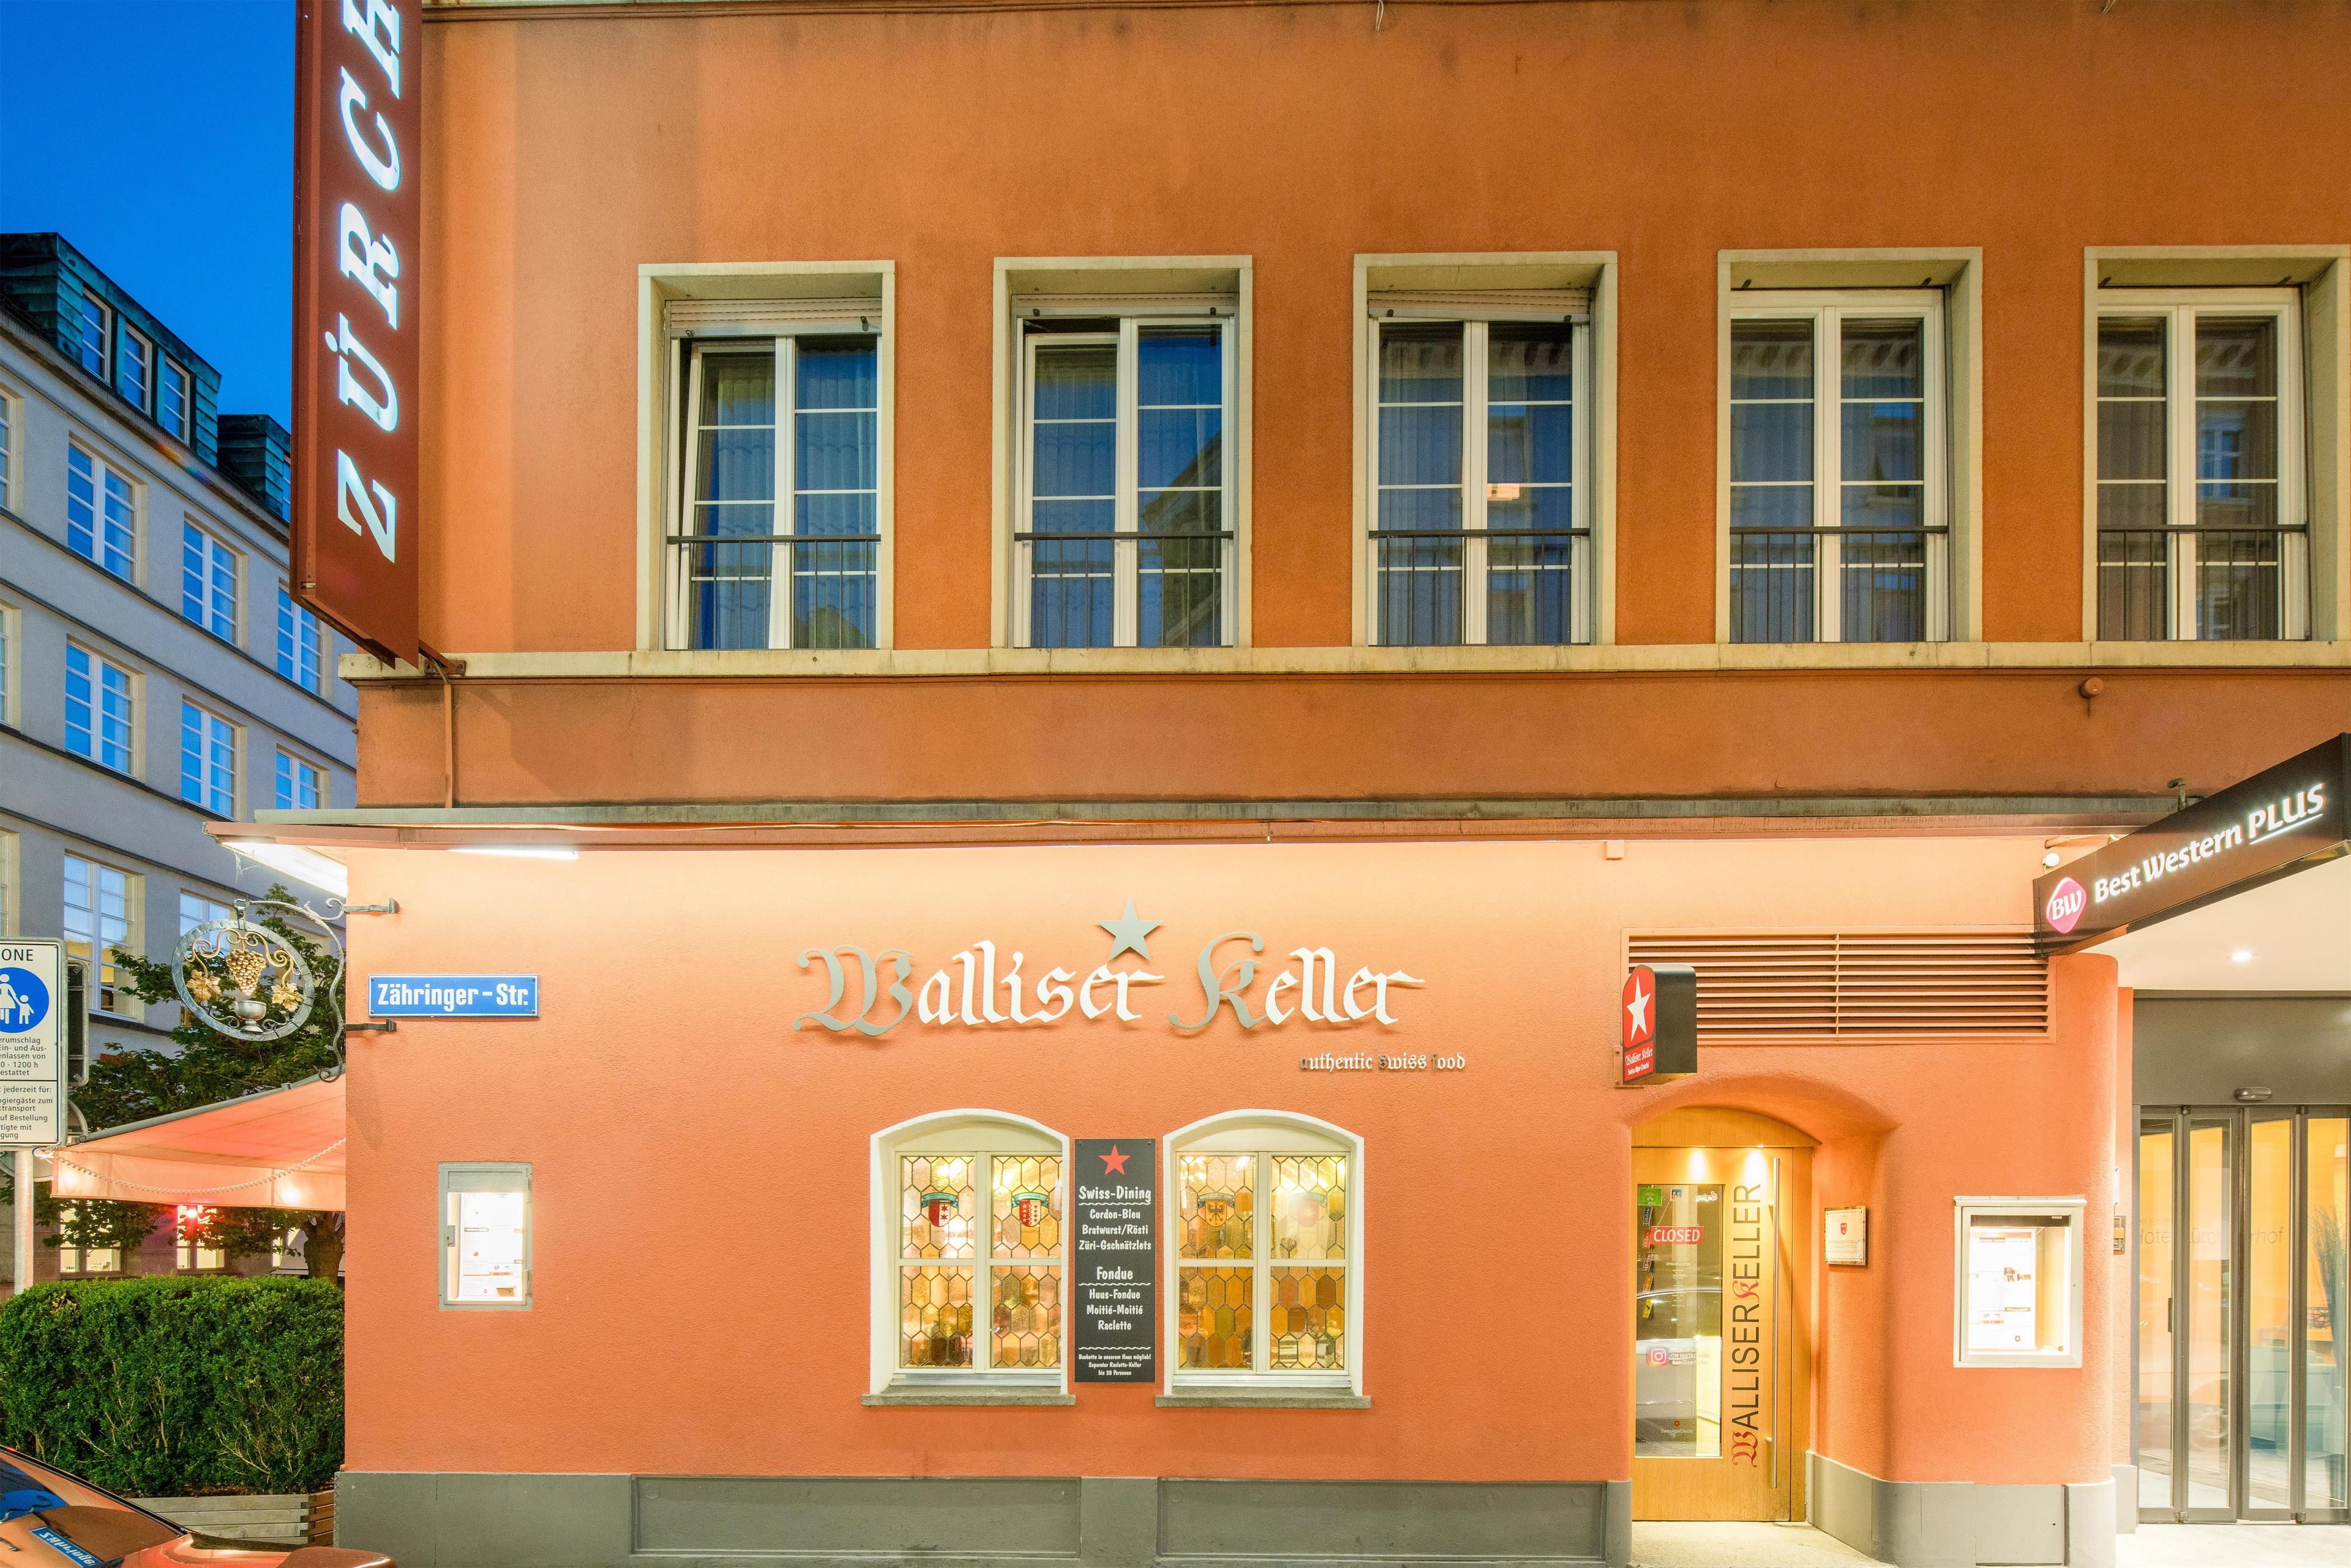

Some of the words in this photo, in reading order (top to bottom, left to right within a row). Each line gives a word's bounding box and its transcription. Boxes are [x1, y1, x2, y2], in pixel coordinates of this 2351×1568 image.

[2094, 868, 2141, 904] Best
[2143, 823, 2243, 882] Western
[2249, 783, 2325, 839] PLUS
[2052, 890, 2082, 921] BW
[793, 940, 1164, 1035] Walliser
[1169, 931, 1425, 1029] Keller
[1300, 1052, 1373, 1072] authentic
[1378, 1052, 1427, 1070] swiss
[1431, 1052, 1466, 1071] food
[4, 1086, 37, 1094] jederzeit
[10, 1114, 48, 1123] Bestellung
[1078, 1185, 1152, 1202] Swiss-Dining
[1089, 1209, 1141, 1219] Cordon-Bleu
[1082, 1224, 1149, 1236] Bratwurst/Rösti
[1653, 1229, 1700, 1242] CLOSED
[1078, 1239, 1152, 1250] Züri-Gschnätzlets
[1097, 1266, 1133, 1280] Fondue
[1089, 1288, 1141, 1299] Huus-Fondue
[1087, 1305, 1143, 1315] Moitié-Moitié
[1098, 1320, 1132, 1330] Raclette
